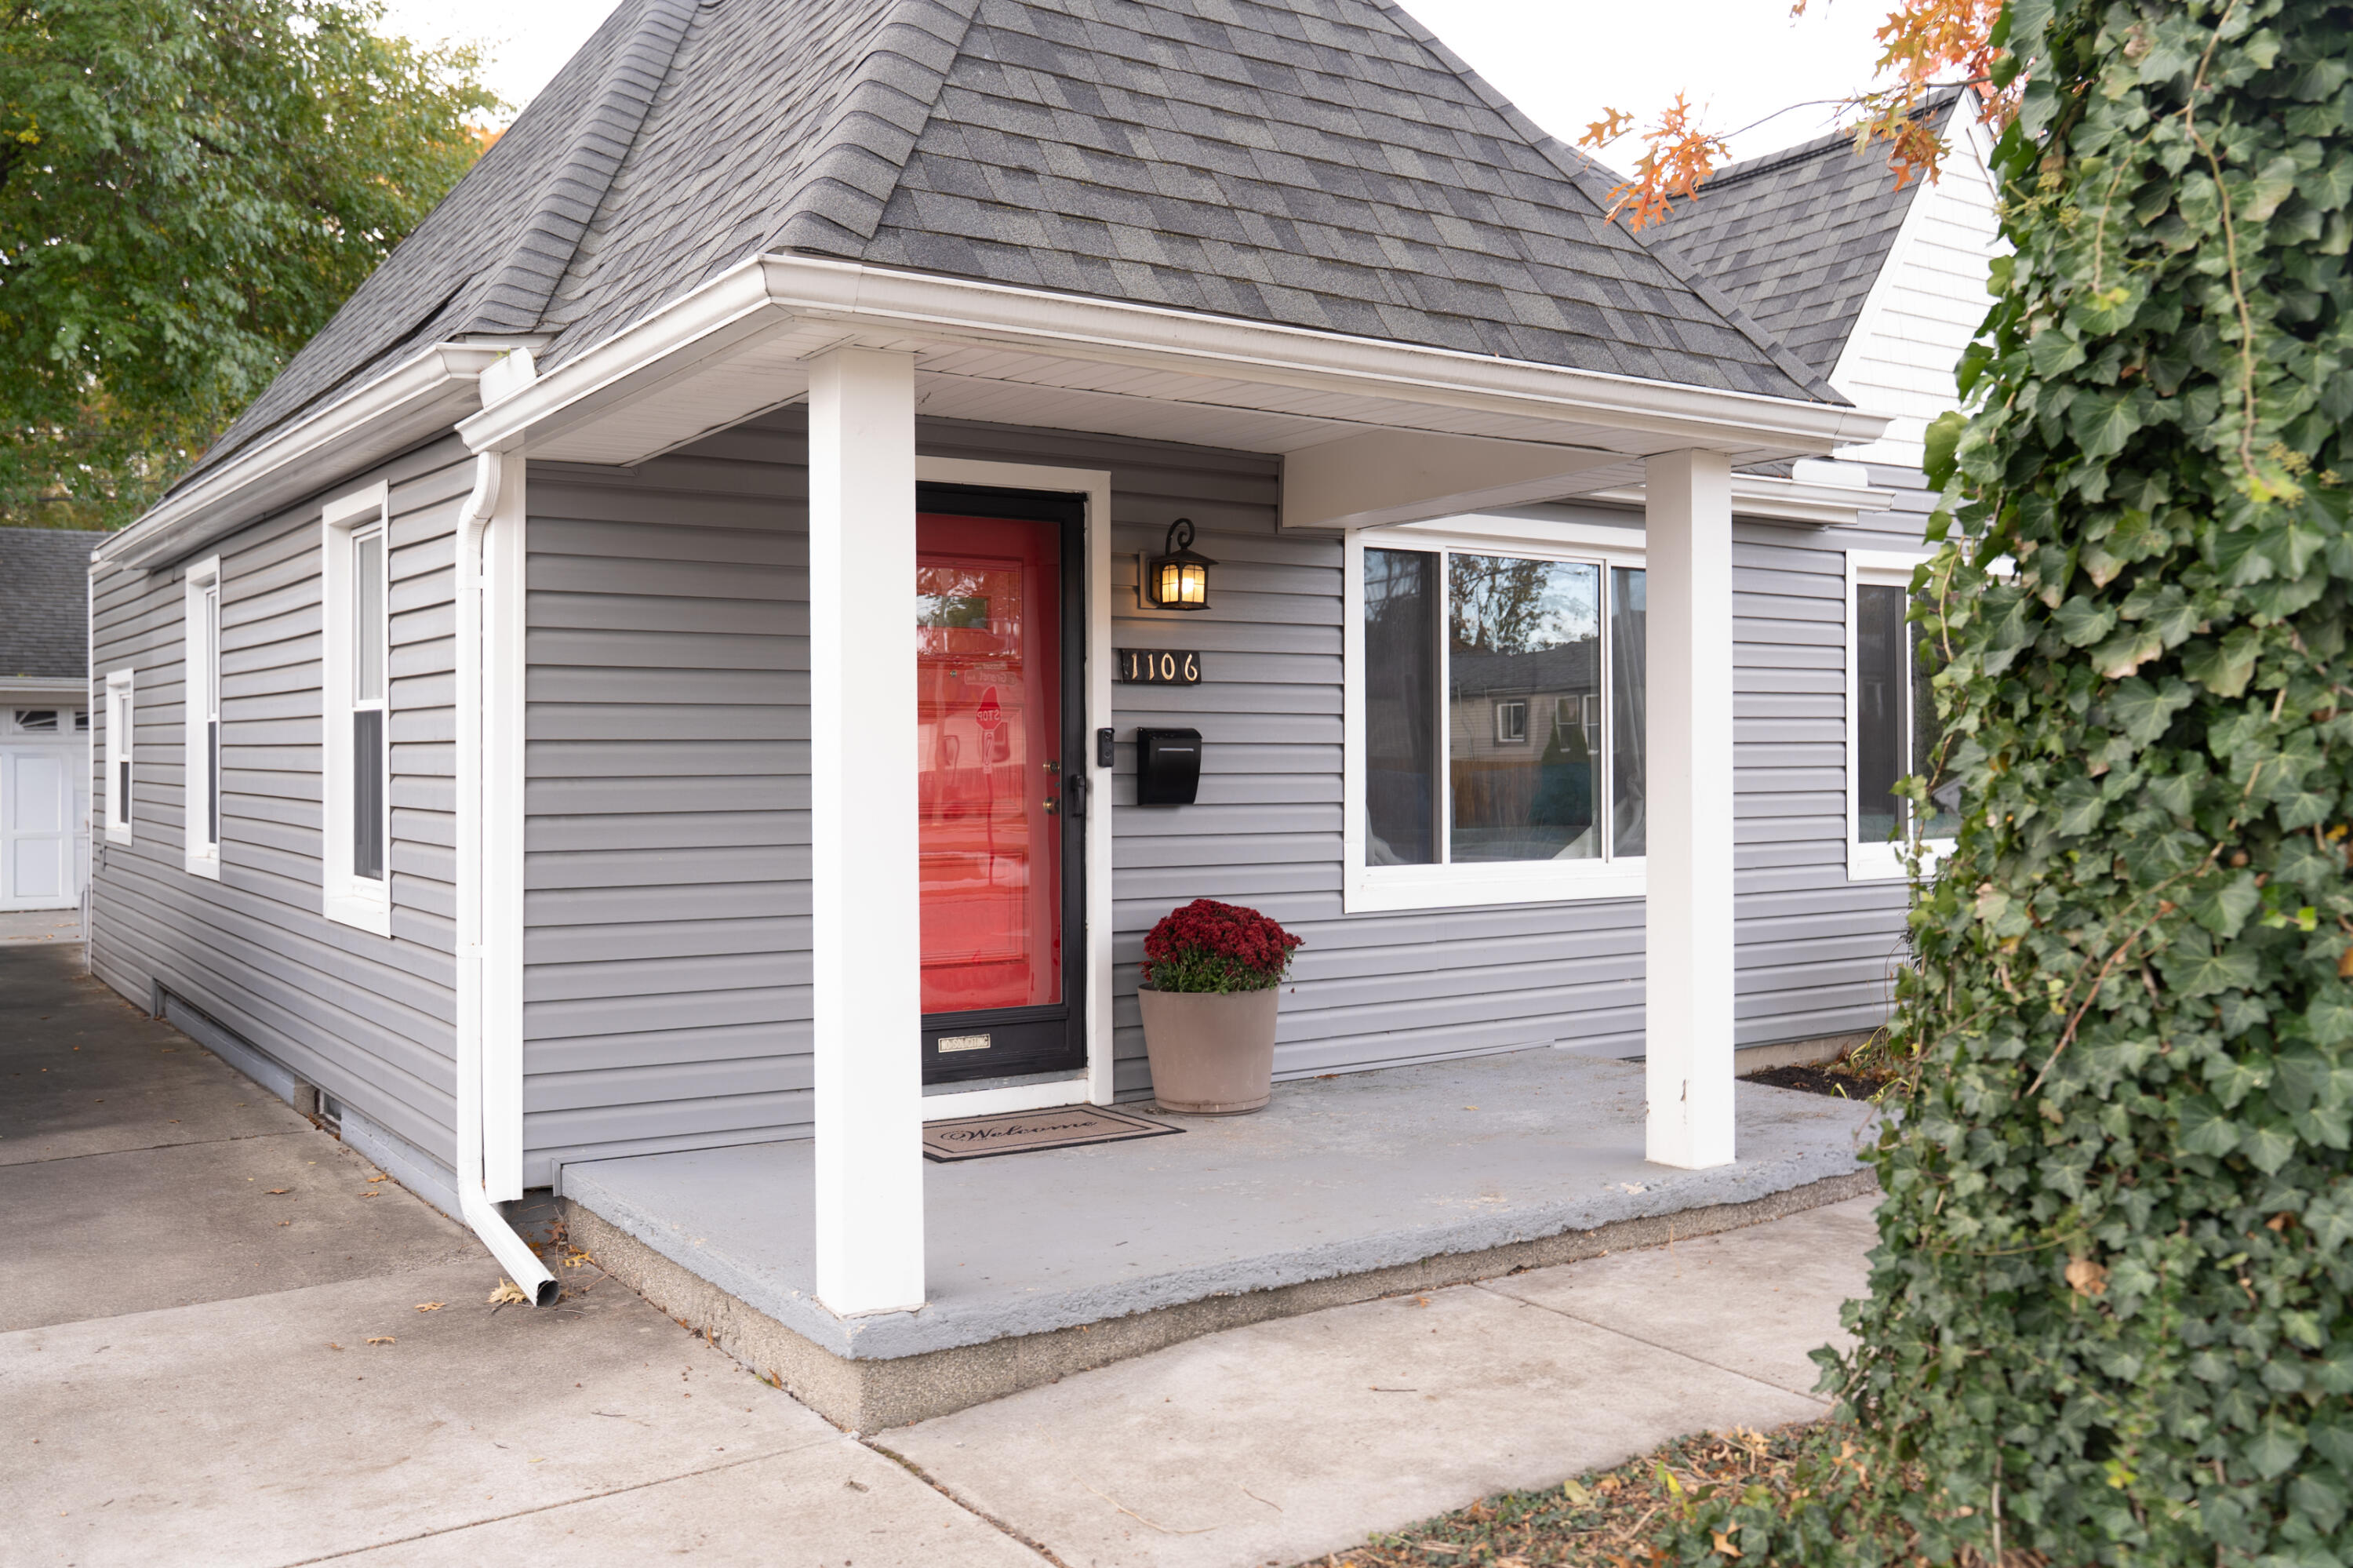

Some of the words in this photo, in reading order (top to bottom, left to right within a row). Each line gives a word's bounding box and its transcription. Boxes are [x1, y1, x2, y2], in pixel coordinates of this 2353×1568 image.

[1132, 653, 1198, 681] 1106
[941, 1039, 951, 1050] NO
[953, 1036, 988, 1049] SOLICITING
[941, 1122, 1097, 1141] Welcome
